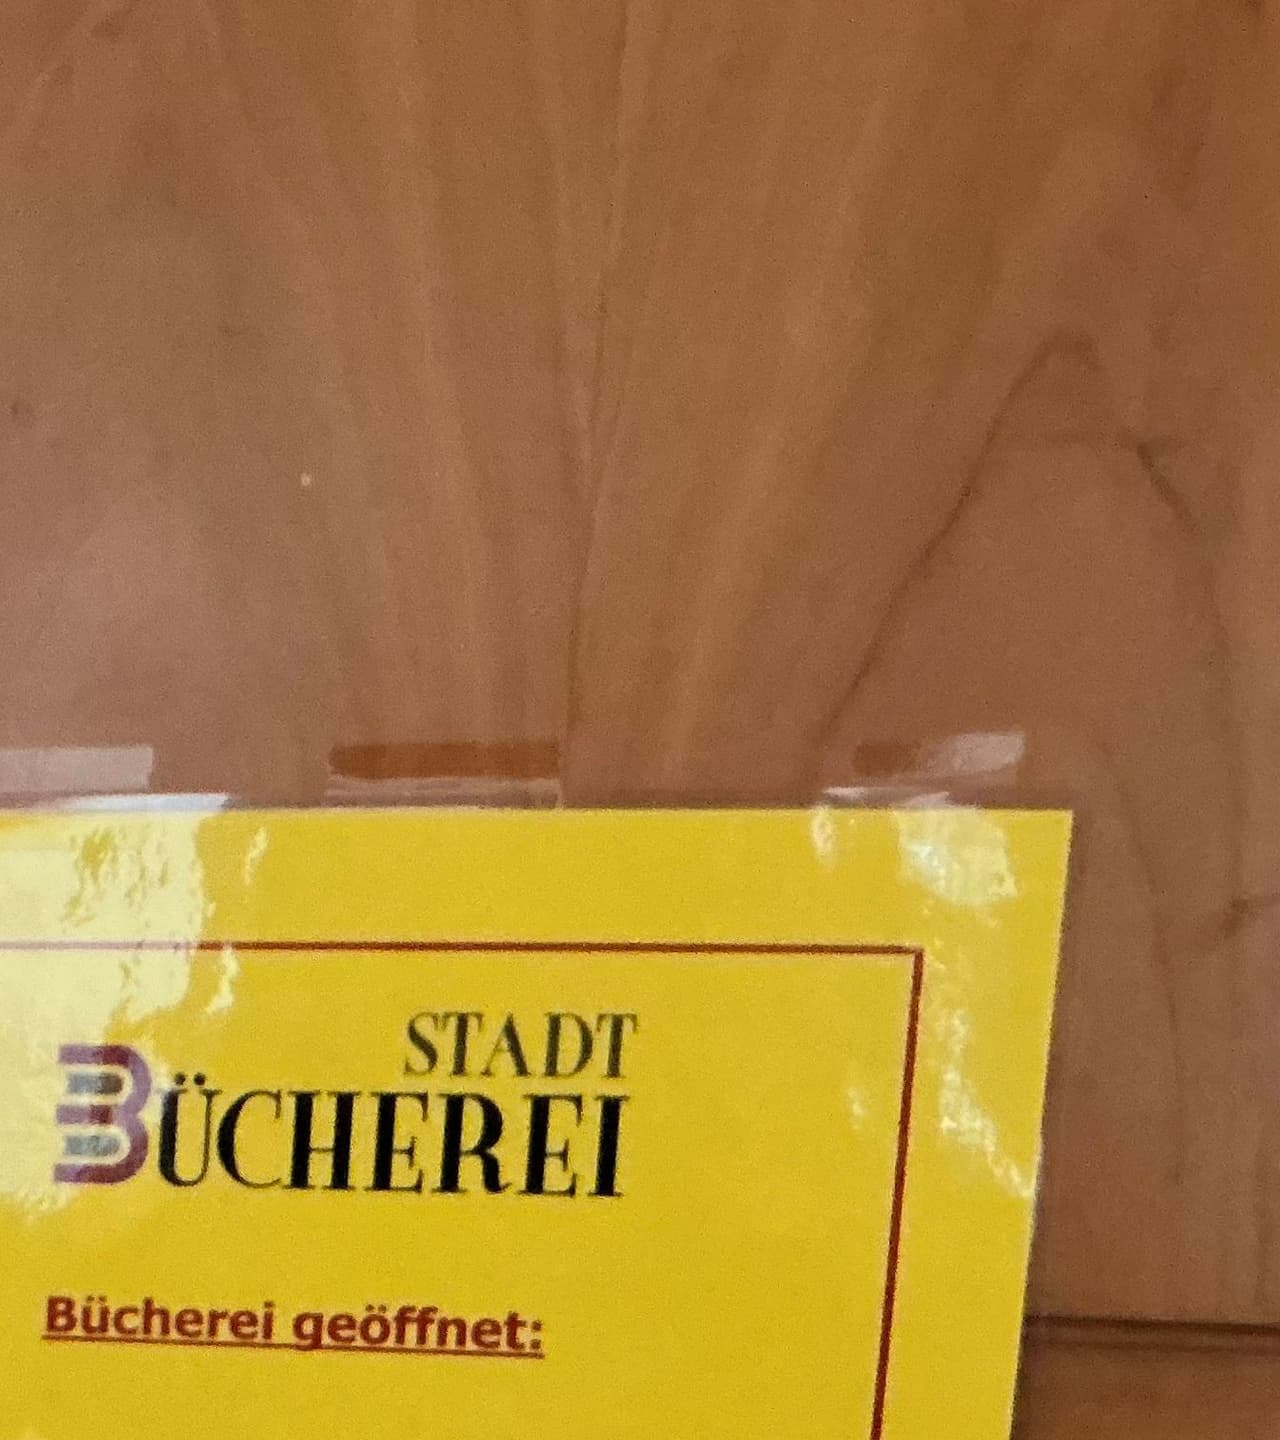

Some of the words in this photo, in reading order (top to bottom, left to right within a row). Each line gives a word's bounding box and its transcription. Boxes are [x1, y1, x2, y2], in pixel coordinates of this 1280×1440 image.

[403, 1010, 638, 1080] STADT
[41, 1294, 278, 1351] Bücherei
[287, 1303, 546, 1360] geöffnet:
